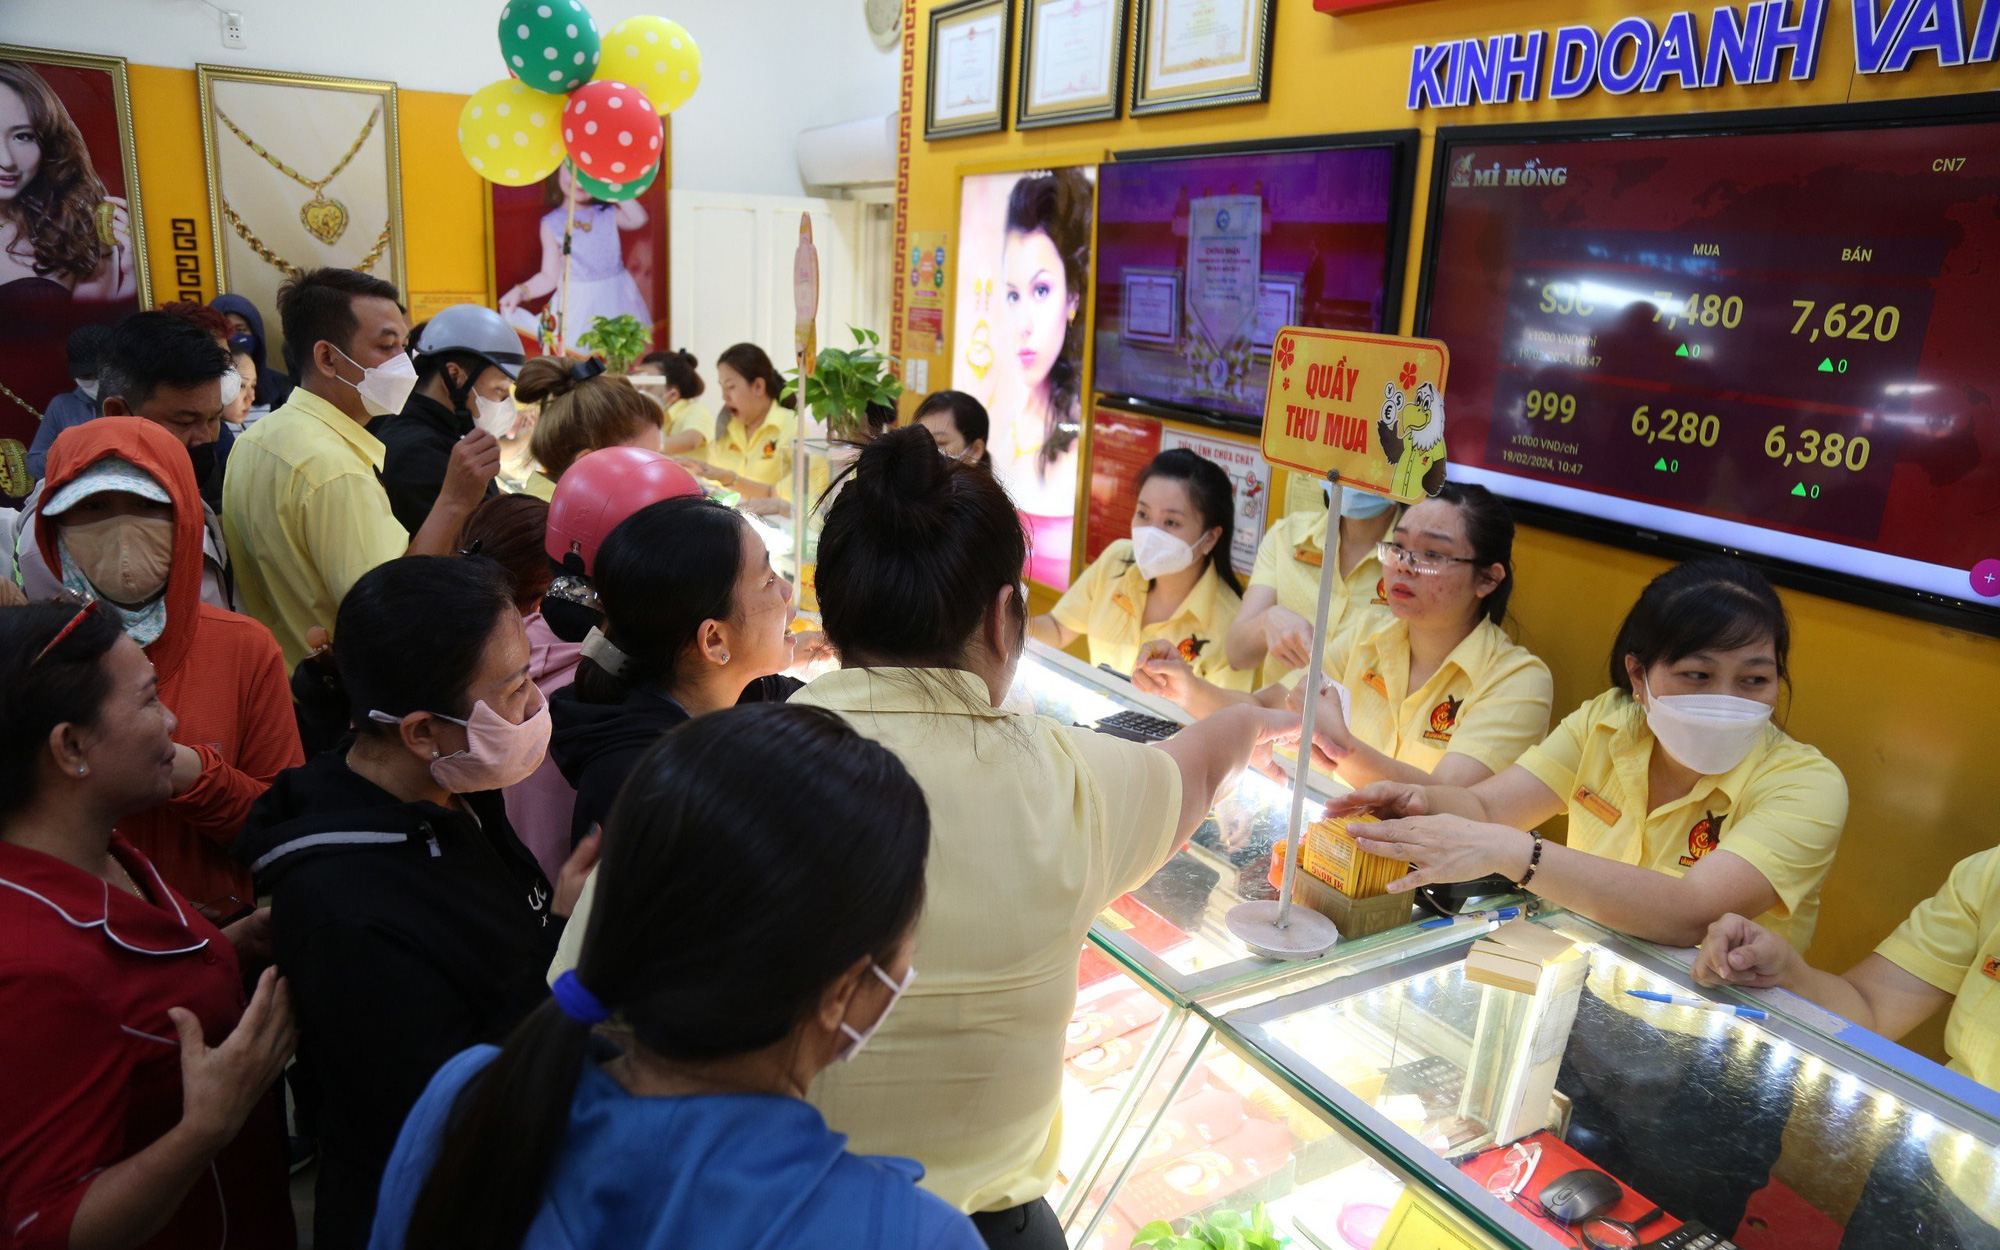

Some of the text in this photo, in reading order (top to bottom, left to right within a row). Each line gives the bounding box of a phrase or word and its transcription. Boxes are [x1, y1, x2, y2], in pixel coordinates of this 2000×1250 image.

[1406, 30, 1546, 110] KINH
[1549, 0, 1826, 98] DOANH
[1504, 157, 1567, 187] HỒNG
[1932, 157, 1967, 172] CN7
[1692, 243, 1720, 256] MUA
[1841, 246, 1872, 262] BÁN
[1539, 283, 1595, 316] SJC
[1652, 291, 1743, 330] 7,480
[1790, 300, 1900, 343] 7,620
[1576, 354, 1602, 368] 10:47
[1692, 344, 1701, 358] 0
[1305, 355, 1360, 402] QUẦY
[1837, 359, 1848, 374] 0
[1526, 389, 1577, 424] 999
[1285, 404, 1368, 454] THU MUA
[1631, 405, 1720, 447] 6,280
[1512, 434, 1539, 447] x1000
[1764, 425, 1870, 472] 6,380
[1503, 450, 1583, 475] 19/02/2024, 10:47
[1670, 459, 1679, 473] 0
[1810, 484, 1820, 499] 0
